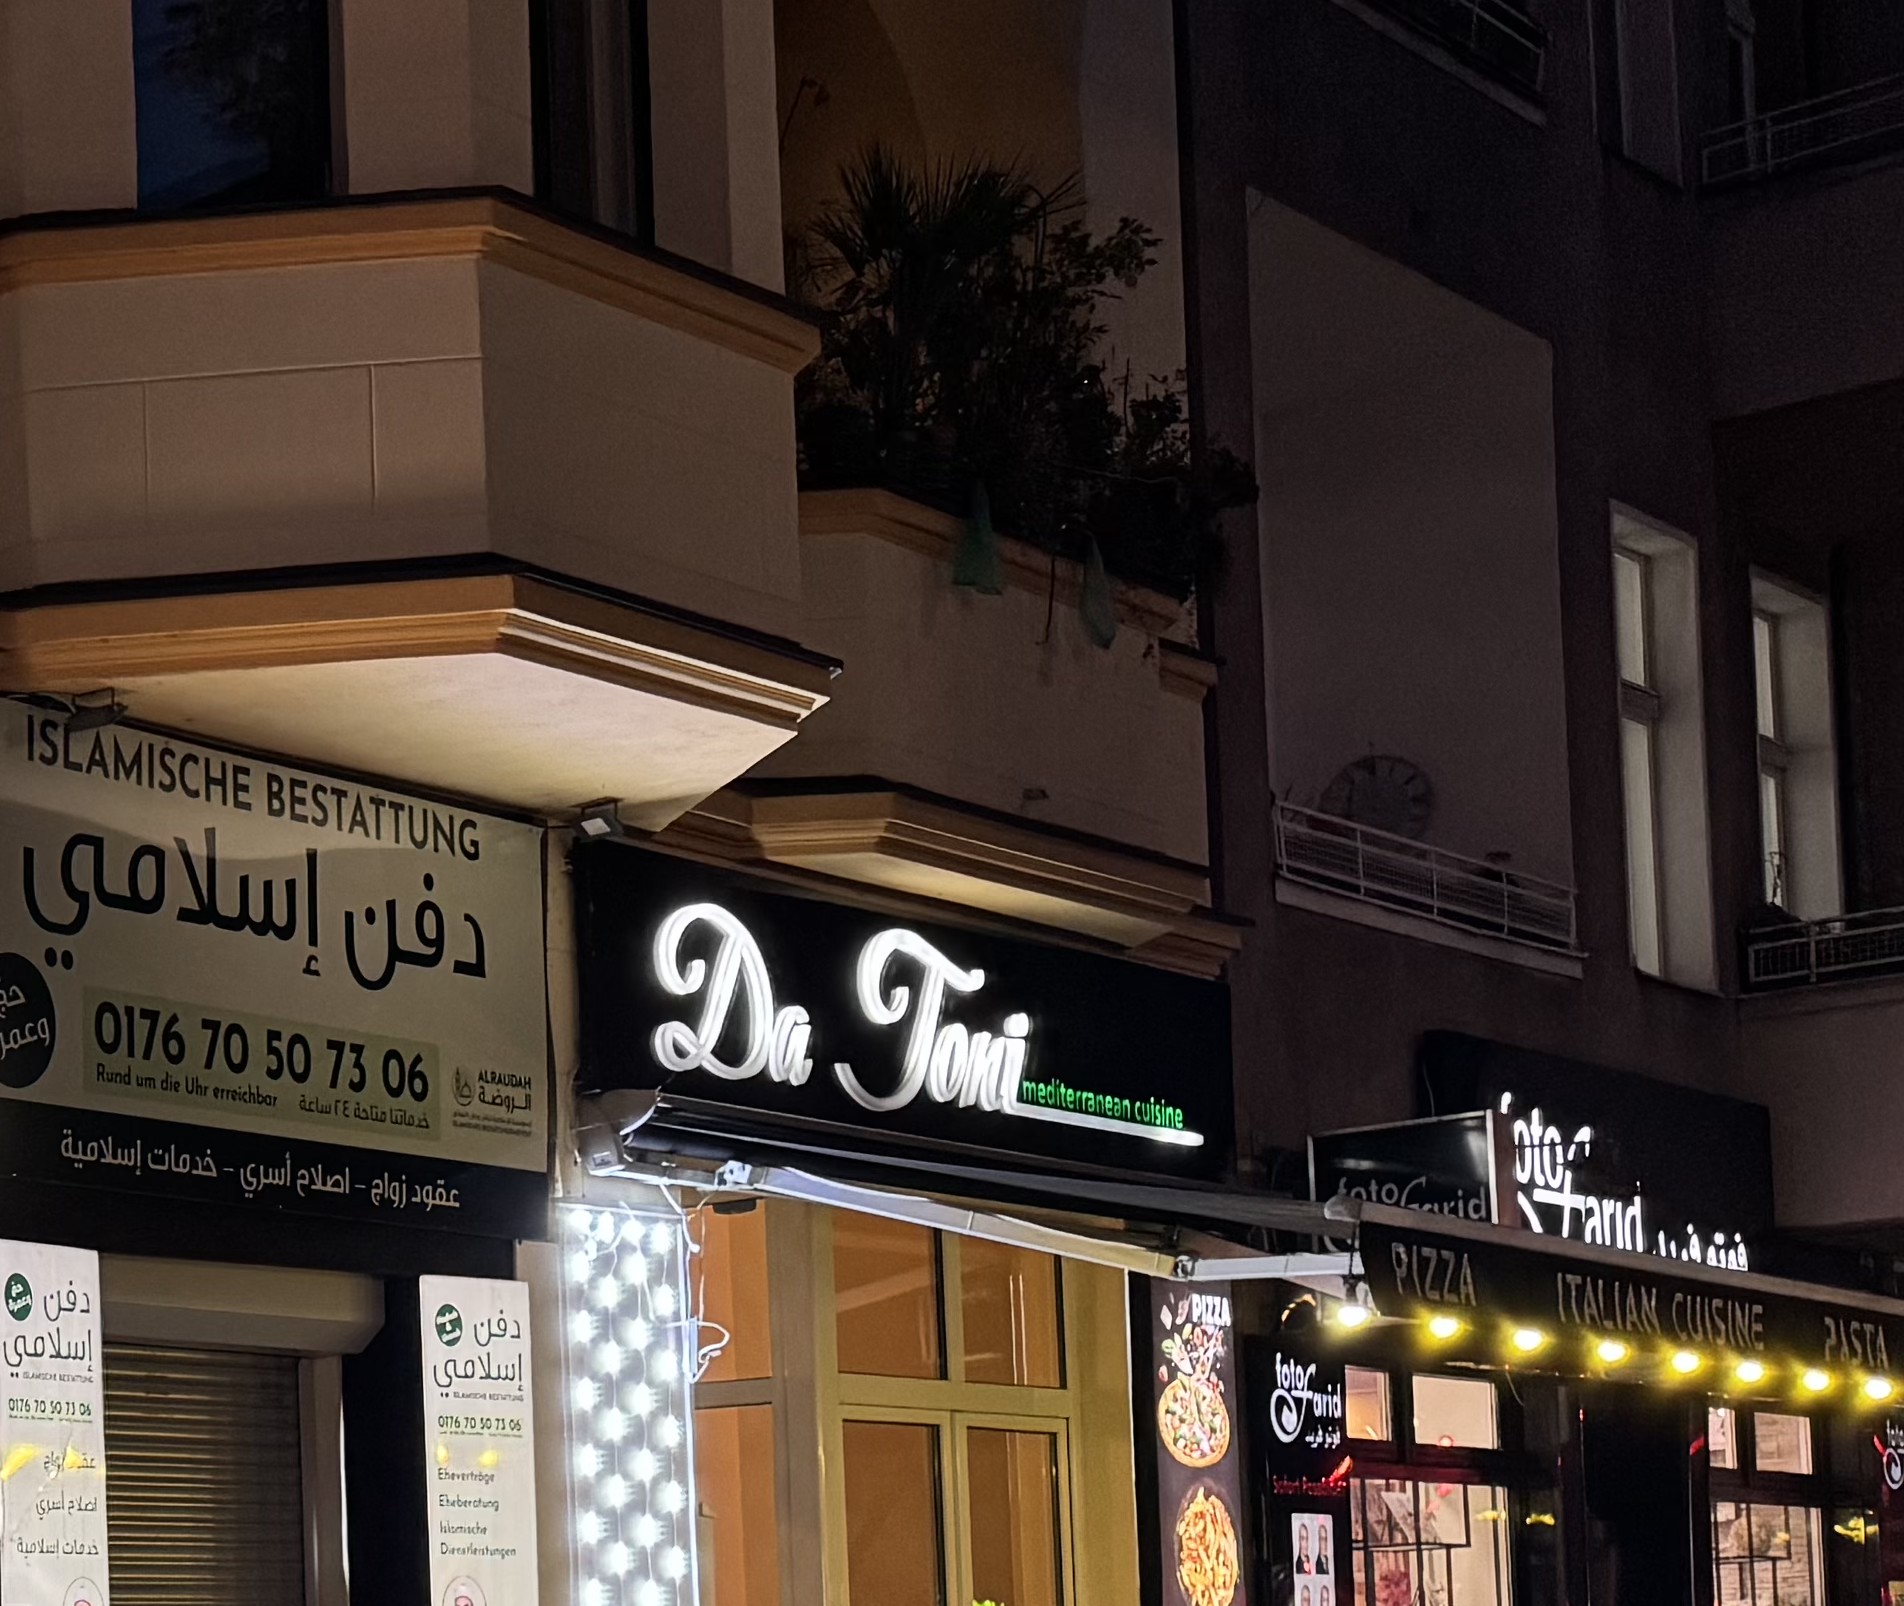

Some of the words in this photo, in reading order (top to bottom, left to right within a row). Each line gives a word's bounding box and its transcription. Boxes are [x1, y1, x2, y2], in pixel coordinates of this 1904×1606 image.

[24, 712, 253, 812] ISLAMISCHE
[265, 771, 481, 862] BESTATTUNG
[22, 826, 321, 978] إسلامي
[343, 871, 487, 991] دفن
[650, 902, 815, 1087] Da
[833, 927, 1032, 1114] Toni
[94, 1001, 186, 1066] 0176
[200, 1018, 250, 1075] 70
[264, 1028, 312, 1085] 50
[326, 1038, 367, 1094] 73
[381, 1048, 430, 1103] 06
[96, 1062, 132, 1087] Rund
[136, 1073, 157, 1091] um
[160, 1071, 182, 1094] die
[184, 1076, 210, 1097] Uhr
[212, 1083, 278, 1108] erreichbar
[1022, 1078, 1131, 1120] mediterranean
[1134, 1096, 1184, 1130] cuisine
[59, 1127, 143, 1176] إسلامية
[146, 1142, 219, 1179] خدمات
[238, 1151, 293, 1200] أسري
[296, 1161, 350, 1197] اصلاح
[370, 1170, 408, 1209] زواج
[410, 1177, 461, 1213] عقود
[1391, 1241, 1477, 1308] PIZZA
[43, 1279, 91, 1323] دفن
[1191, 1293, 1232, 1328] PIZZA
[1556, 1271, 1662, 1336] ITALIAN
[1671, 1291, 1765, 1353] CUISINE
[473, 1308, 521, 1348] دفن
[1823, 1314, 1890, 1371] PASTA
[2, 1326, 94, 1380] إسلامي
[433, 1351, 524, 1399] إسلامي
[7, 1397, 31, 1413] 0176
[33, 1398, 47, 1414] 70
[437, 1415, 461, 1430] 0176
[463, 1416, 477, 1430] 70
